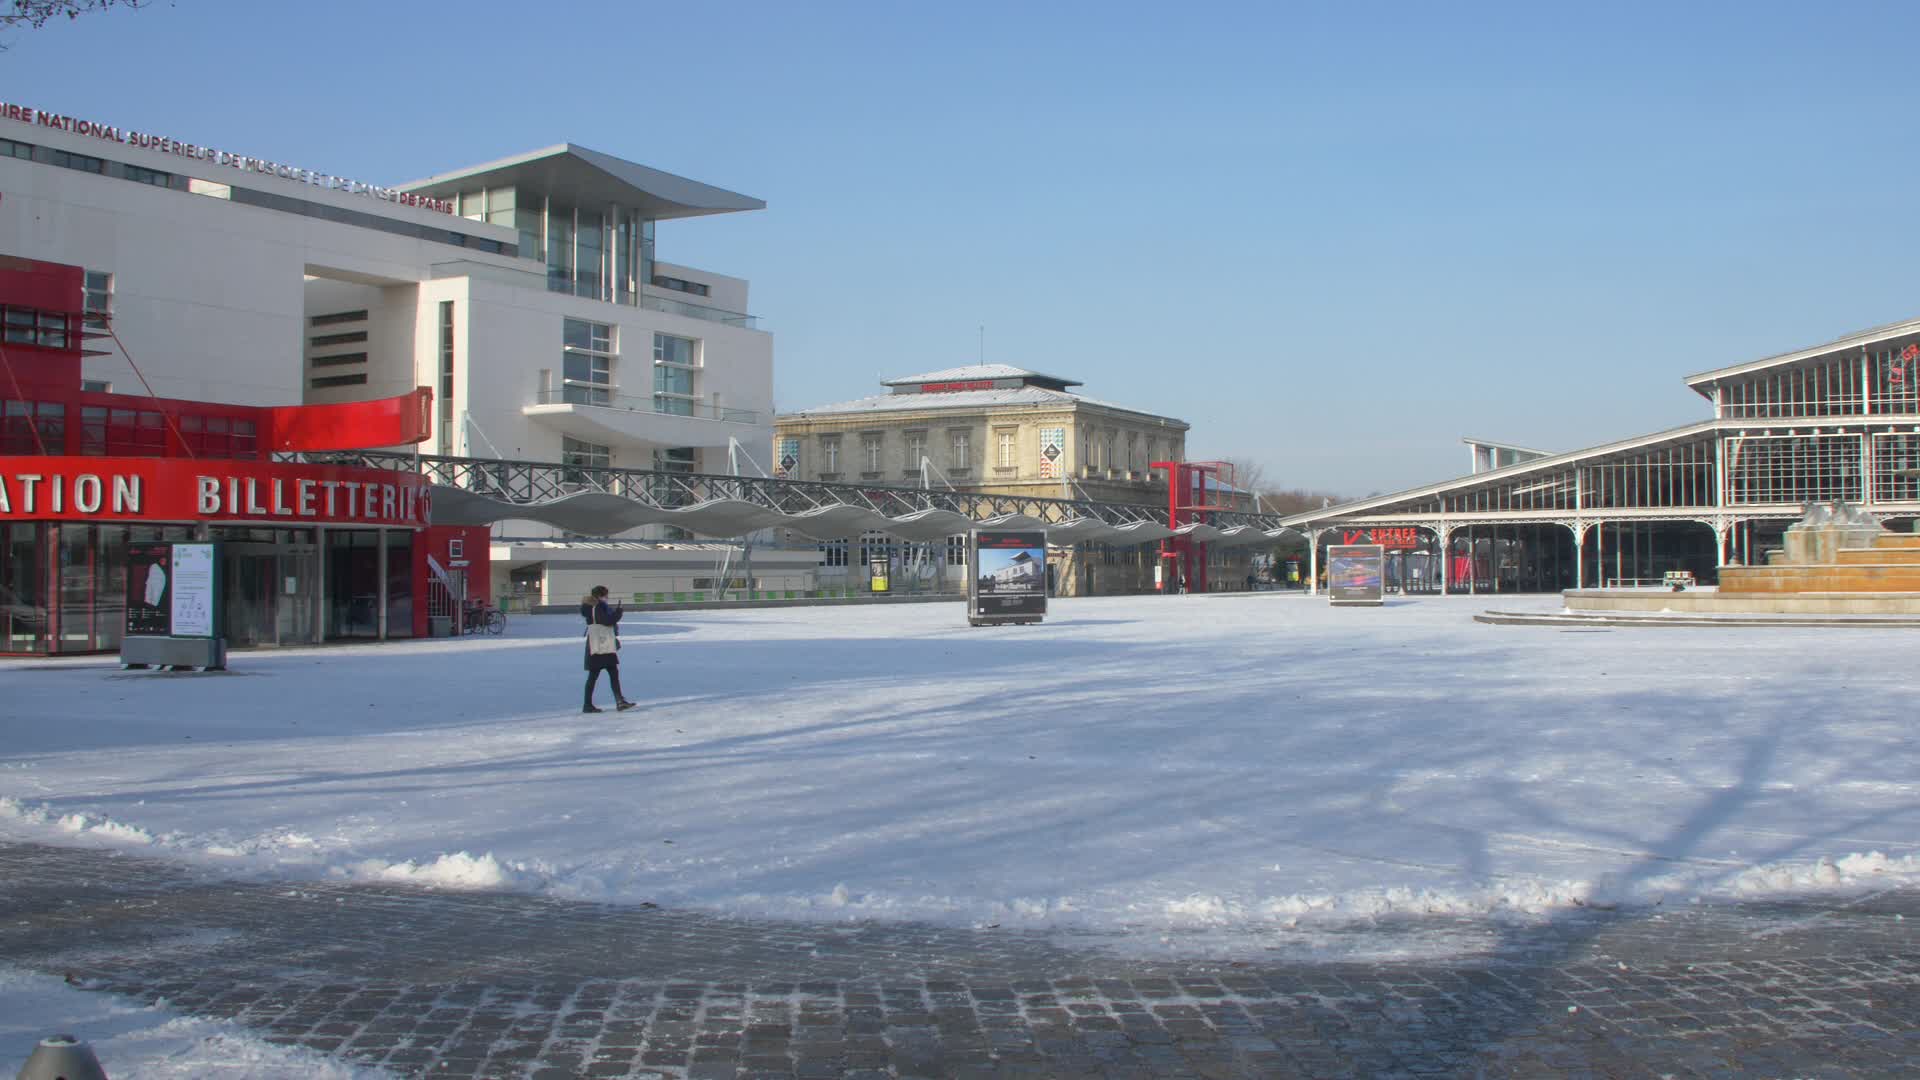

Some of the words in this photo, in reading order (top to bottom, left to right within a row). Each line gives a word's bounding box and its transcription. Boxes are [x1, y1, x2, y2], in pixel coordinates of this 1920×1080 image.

[0, 102, 33, 123] IRE
[37, 110, 125, 143] NATIONAL
[129, 131, 217, 164] SUPÉRIEUR
[221, 151, 240, 169] DE
[333, 176, 350, 192] DE
[400, 191, 416, 207] DE
[418, 195, 453, 214] PARIS
[196, 475, 416, 521] BILLETTERIE
